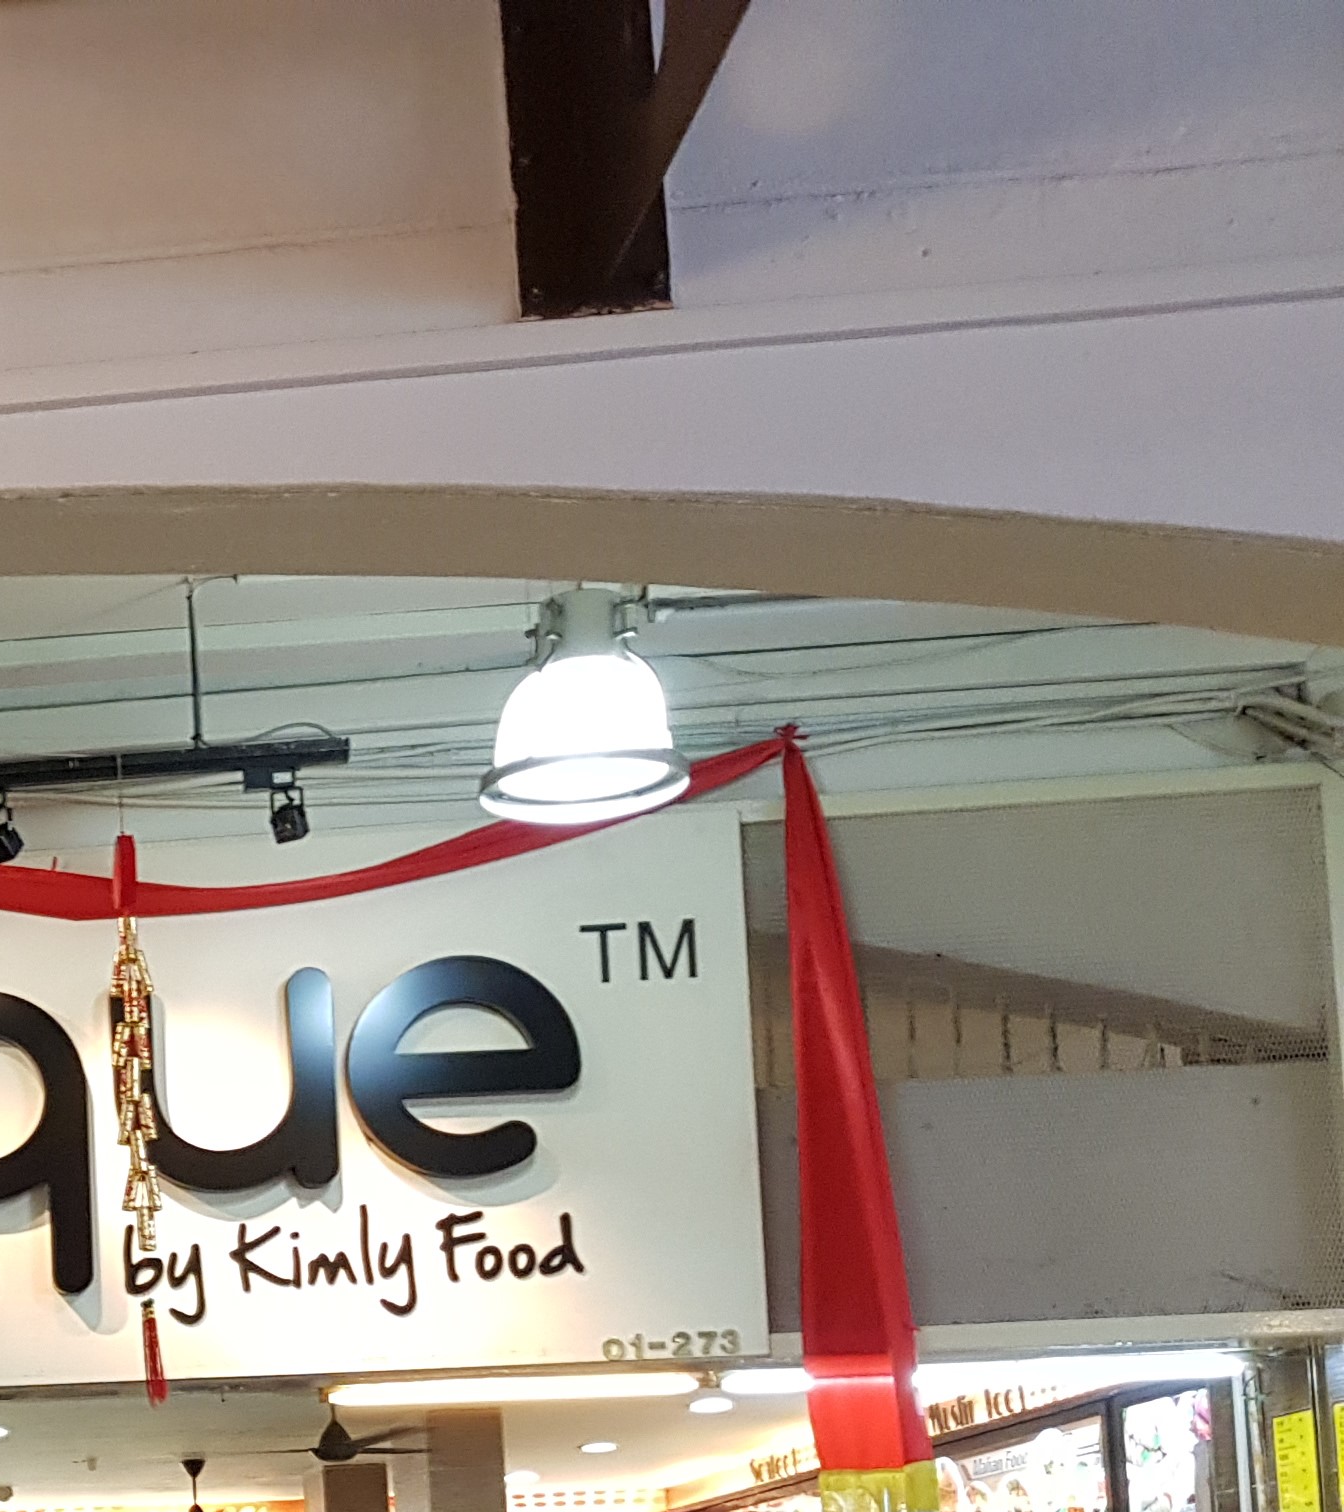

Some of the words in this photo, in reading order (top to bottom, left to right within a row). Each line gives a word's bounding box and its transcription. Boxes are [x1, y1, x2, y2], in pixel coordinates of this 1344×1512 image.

[579, 917, 698, 984] TM
[123, 1224, 206, 1326] by
[229, 1203, 418, 1317] Kimly
[435, 1210, 586, 1283] Food
